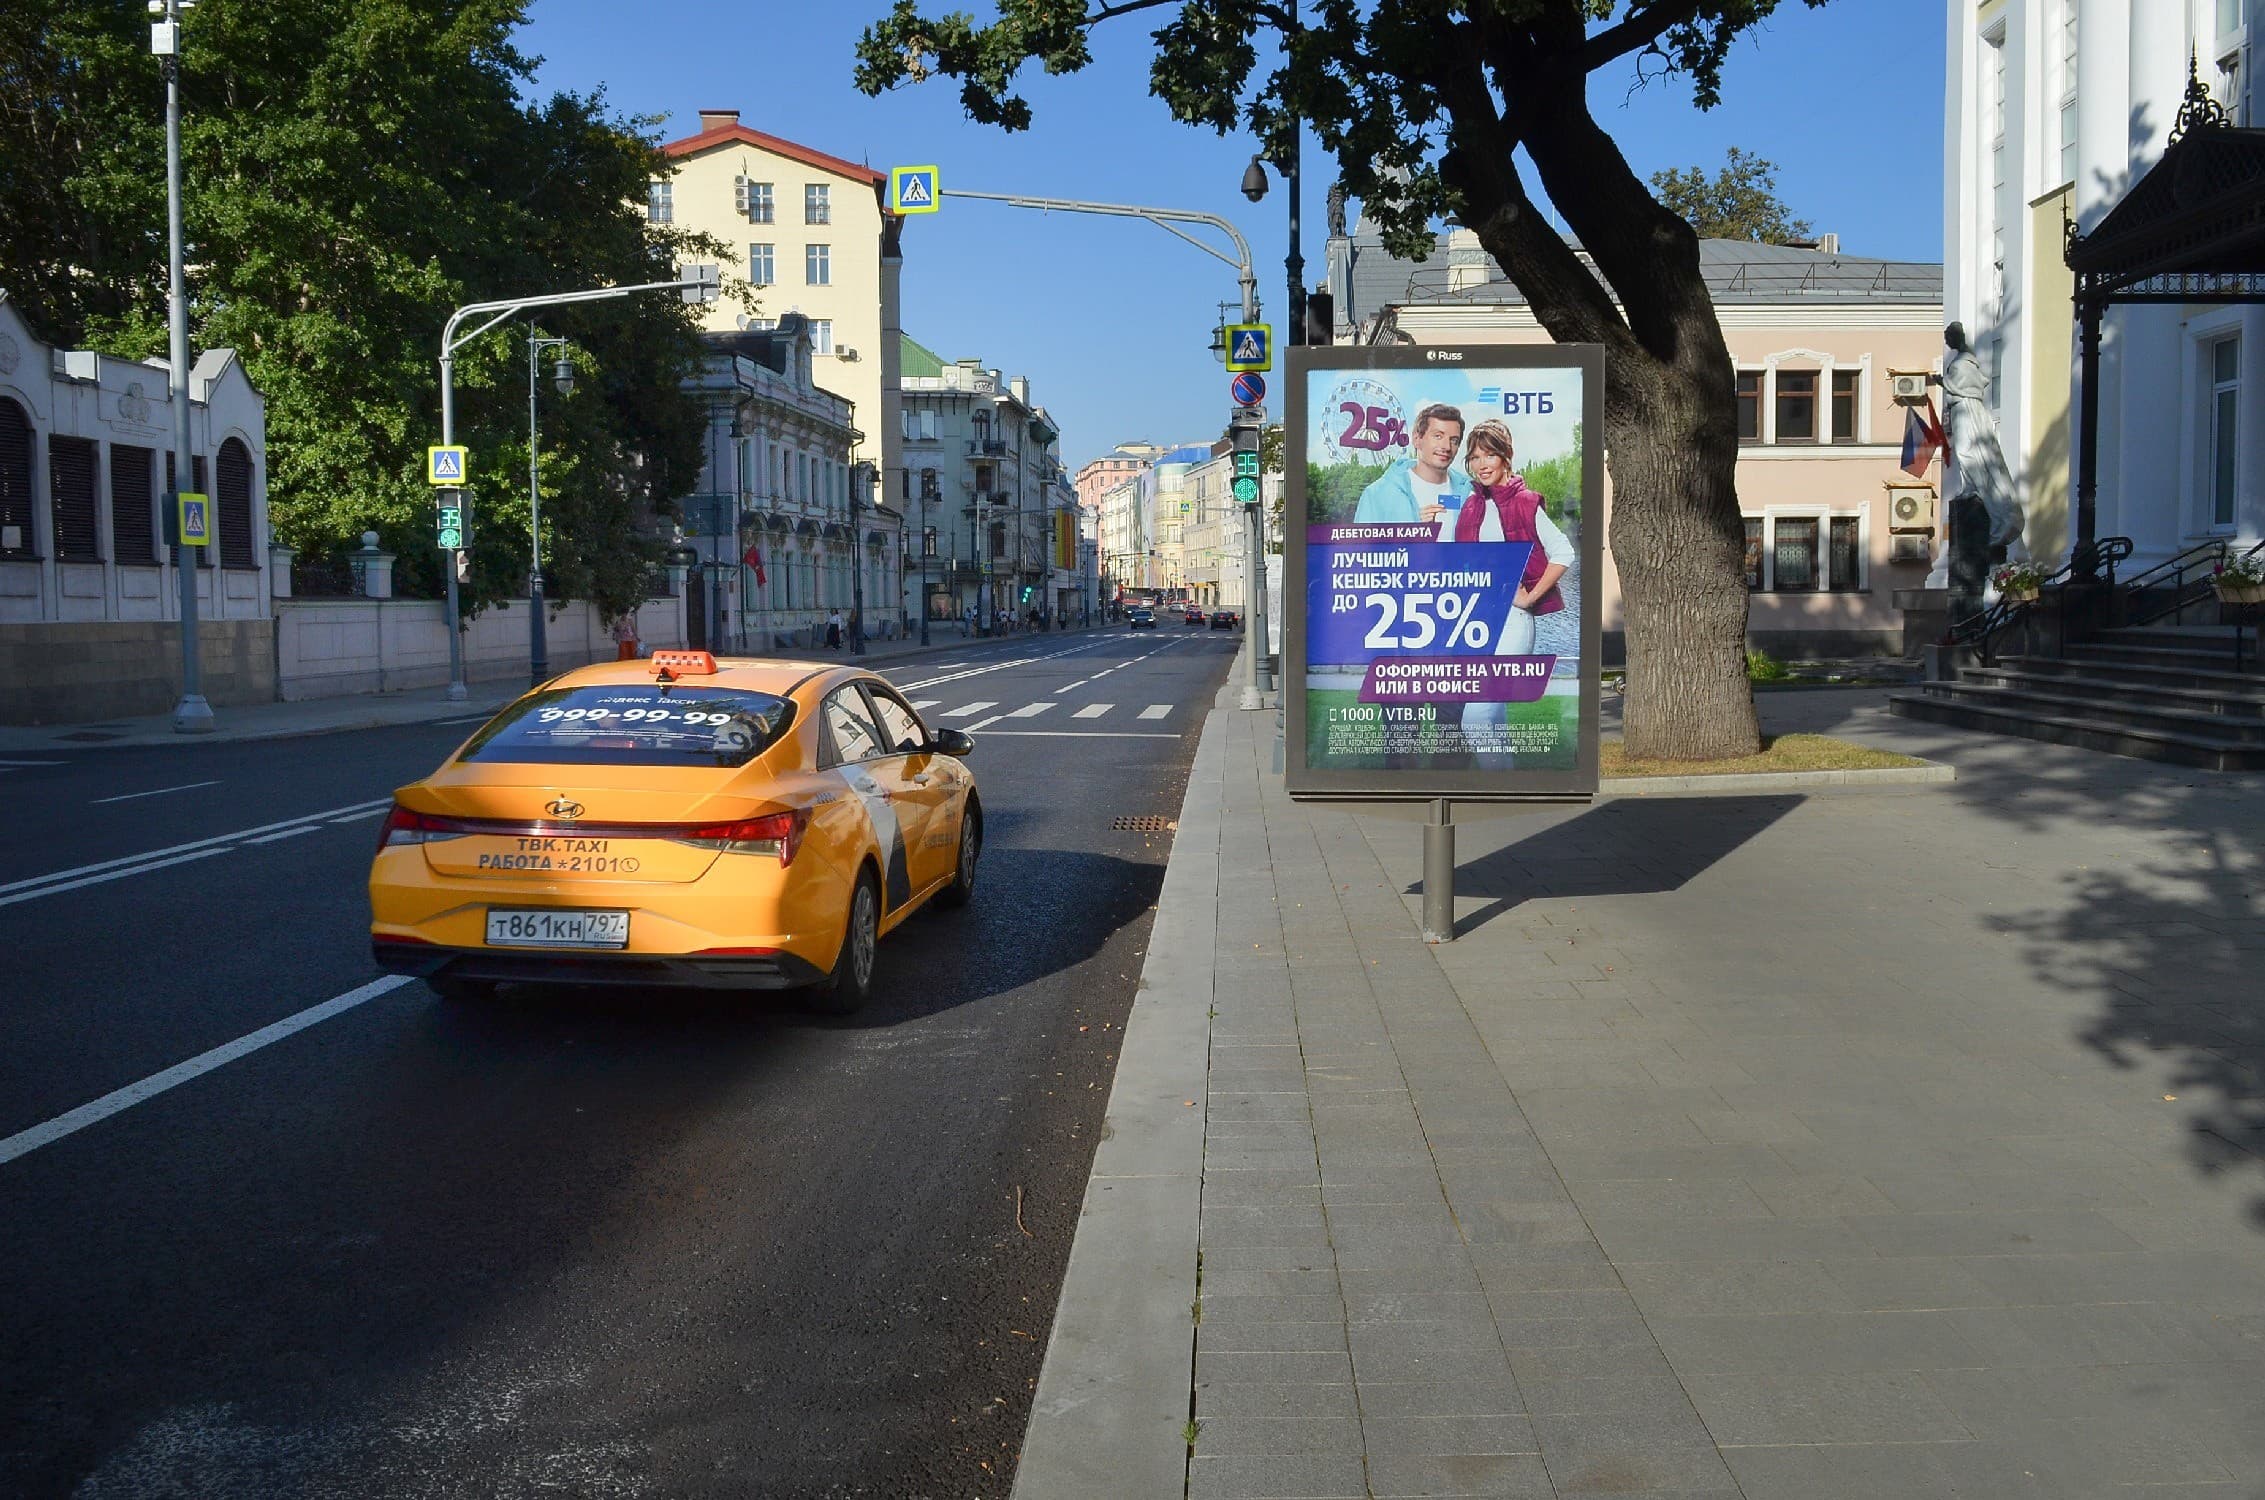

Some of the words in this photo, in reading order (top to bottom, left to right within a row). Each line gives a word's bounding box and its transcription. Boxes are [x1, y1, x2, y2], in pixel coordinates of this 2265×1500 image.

[1438, 350, 1463, 361] Russ
[1503, 391, 1554, 415] ВТБ
[1339, 401, 1410, 451] 25%
[1237, 454, 1257, 475] 35
[441, 509, 459, 527] 35
[1331, 528, 1394, 541] ДЕБЕТОВАЯ
[1396, 526, 1433, 538] КАРТА
[1332, 548, 1409, 568] ЛУЧШИЙ
[1332, 573, 1404, 589] КЕШБЭК
[1408, 571, 1492, 588] РУБЛЯМИ
[1332, 594, 1358, 614] ДО
[1364, 592, 1490, 649] 25%
[1375, 663, 1462, 678] ОФОРМИТЕ
[1466, 663, 1488, 677] НА
[1491, 662, 1546, 677] VTB.RU
[1375, 681, 1408, 695] ИЛИ
[1412, 680, 1422, 694] В
[1426, 680, 1480, 694] ОФИСЕ
[539, 708, 731, 726] 999-99-99
[1340, 708, 1374, 721] 1000
[1386, 708, 1437, 721] VTB.RU
[478, 853, 552, 870] РАБОТА
[587, 915, 621, 932] 797
